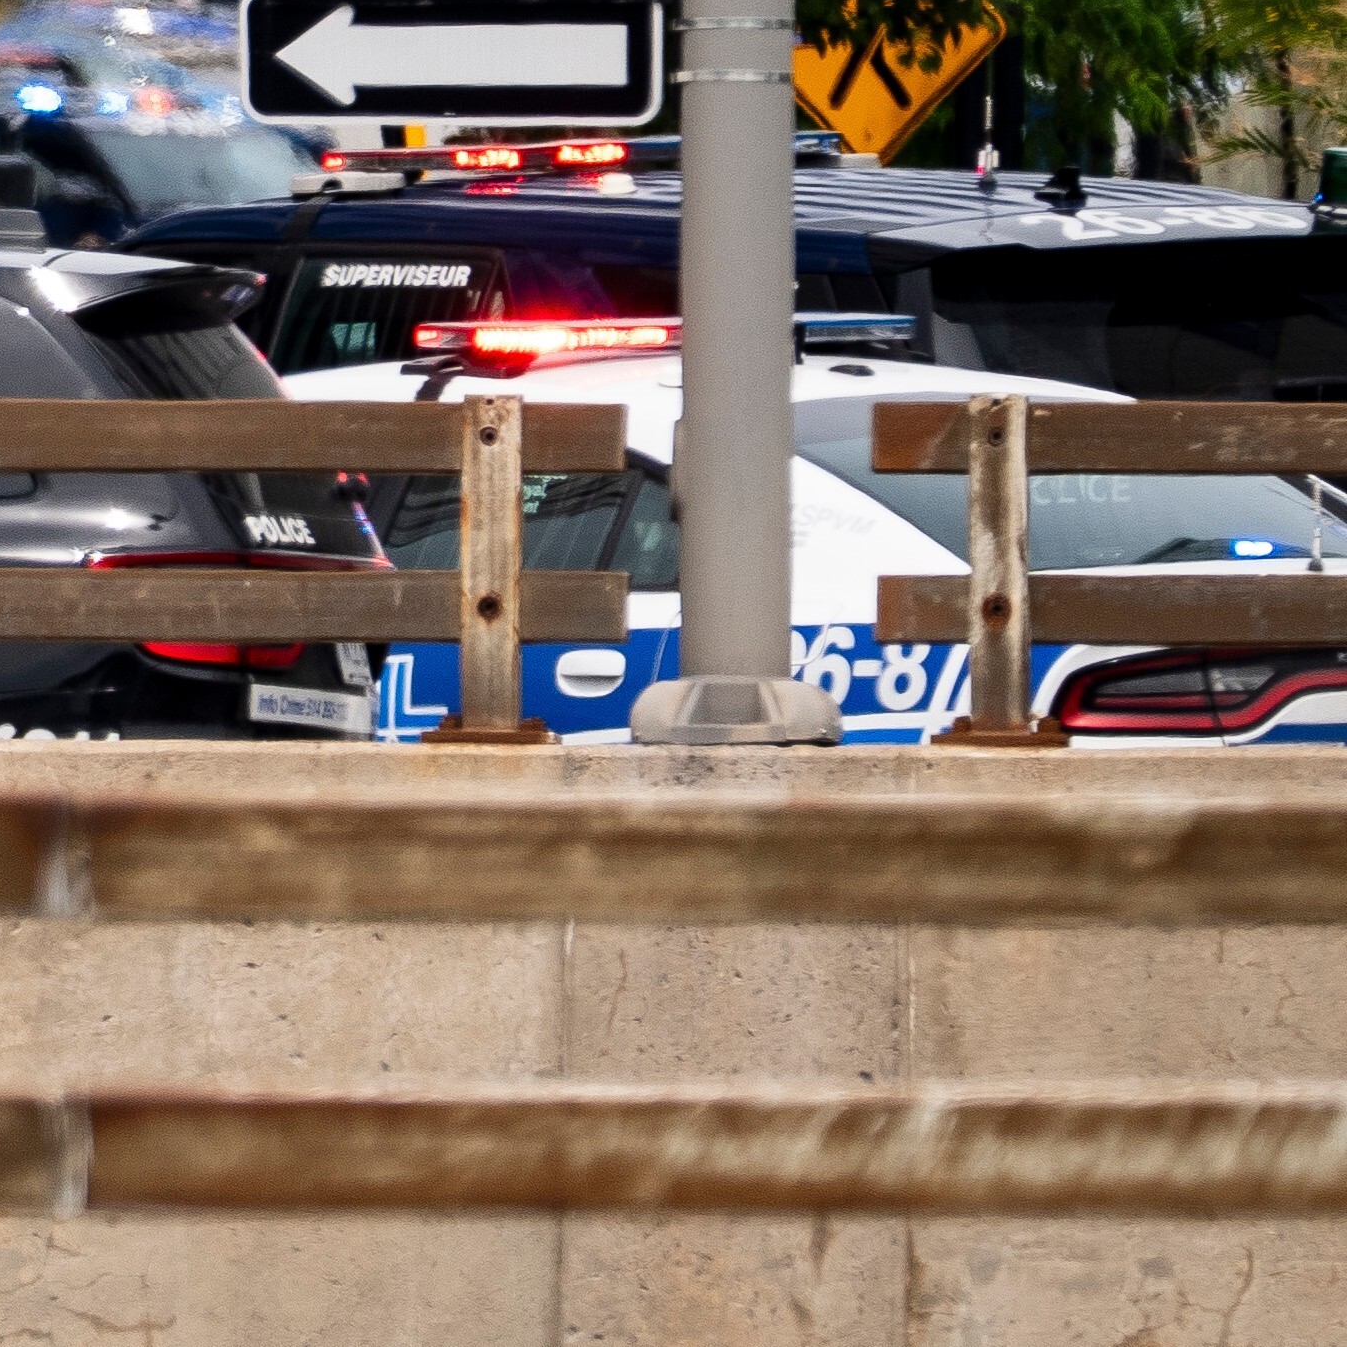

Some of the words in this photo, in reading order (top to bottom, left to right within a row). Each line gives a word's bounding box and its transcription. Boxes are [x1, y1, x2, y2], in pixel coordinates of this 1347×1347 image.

[1019, 205, 1307, 241] 26-86
[320, 263, 472, 288] SUPERVISEUR
[243, 515, 317, 544] POLICE
